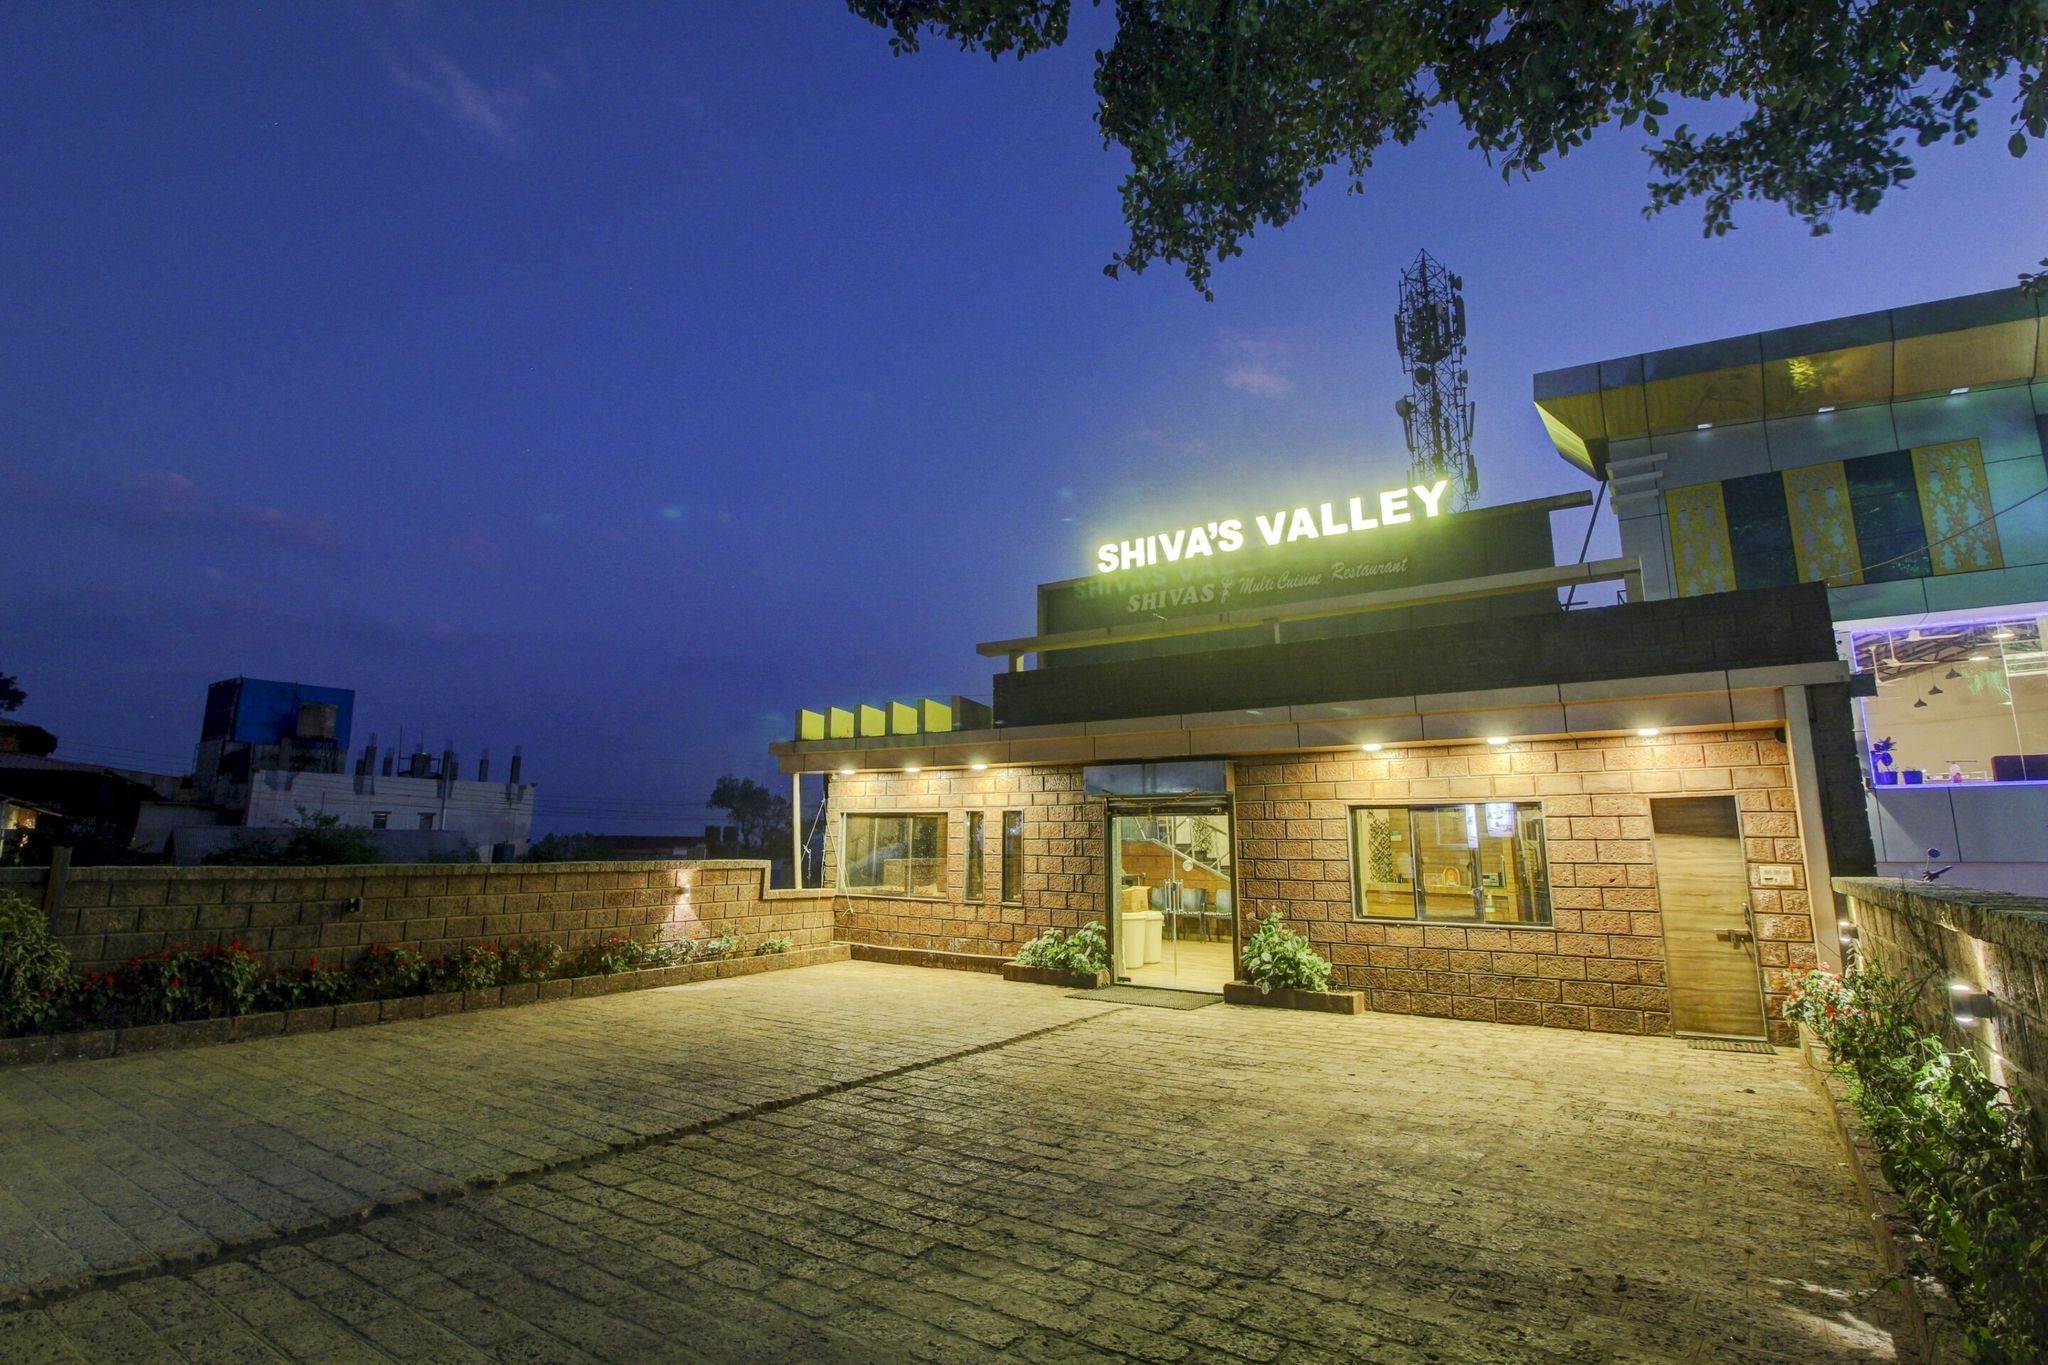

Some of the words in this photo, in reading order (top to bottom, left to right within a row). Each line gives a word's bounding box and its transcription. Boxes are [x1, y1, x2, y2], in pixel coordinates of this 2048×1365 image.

[1097, 519, 1244, 573] SHIVA'S
[1255, 480, 1448, 546] VALLEY
[1127, 583, 1215, 613] SHIVAS
[1240, 575, 1275, 595] Multi
[1277, 571, 1322, 590] Cuisine
[1330, 558, 1409, 581] Restaurant
